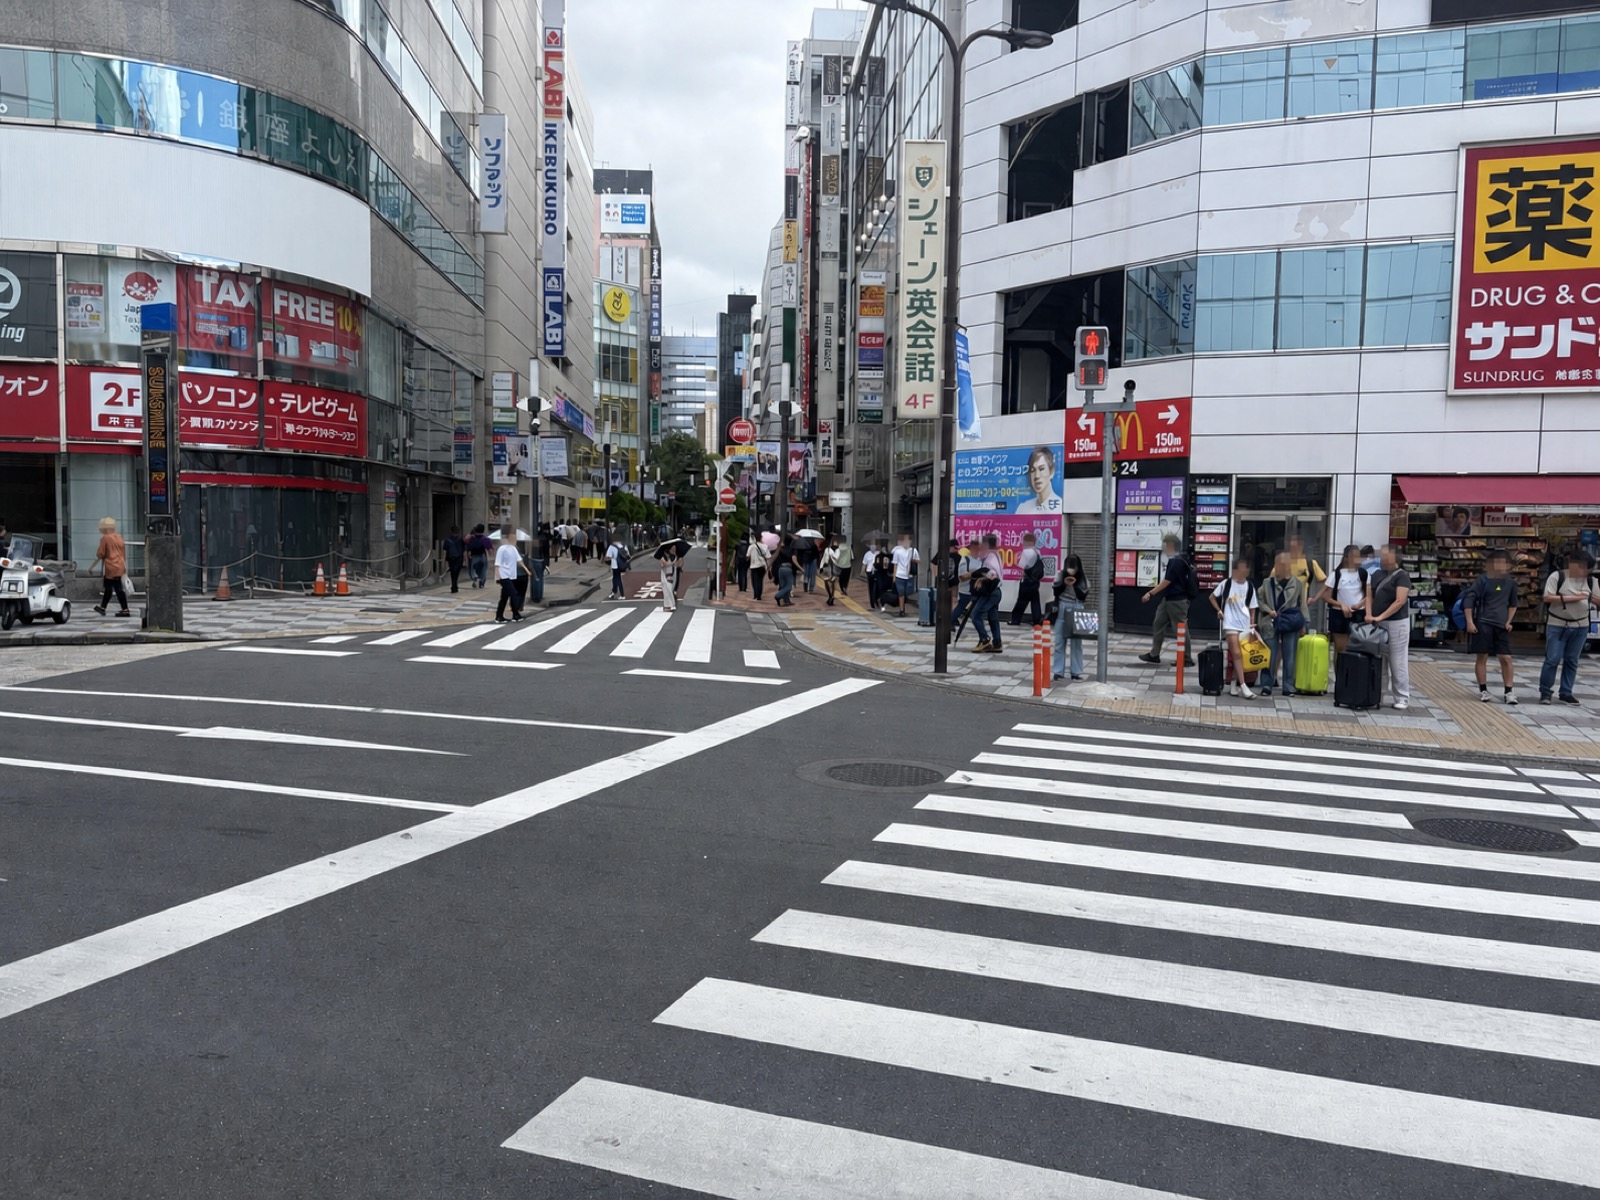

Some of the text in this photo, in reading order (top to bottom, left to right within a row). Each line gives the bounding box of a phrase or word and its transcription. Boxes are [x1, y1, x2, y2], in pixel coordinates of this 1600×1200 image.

[544, 51, 563, 236] LABI IKEBUKURO
[1484, 163, 1595, 264] 薬
[195, 270, 334, 326] TAX FREE
[904, 198, 939, 383] シェーン英会話
[1471, 286, 1546, 307] DRUG
[1555, 284, 1575, 305] &
[545, 295, 562, 351] LABI
[1465, 316, 1600, 361] サンド
[103, 382, 141, 407] 2F
[1463, 370, 1545, 384] SUNDRUG
[905, 393, 935, 410] 4F
[1121, 461, 1138, 475] 24
